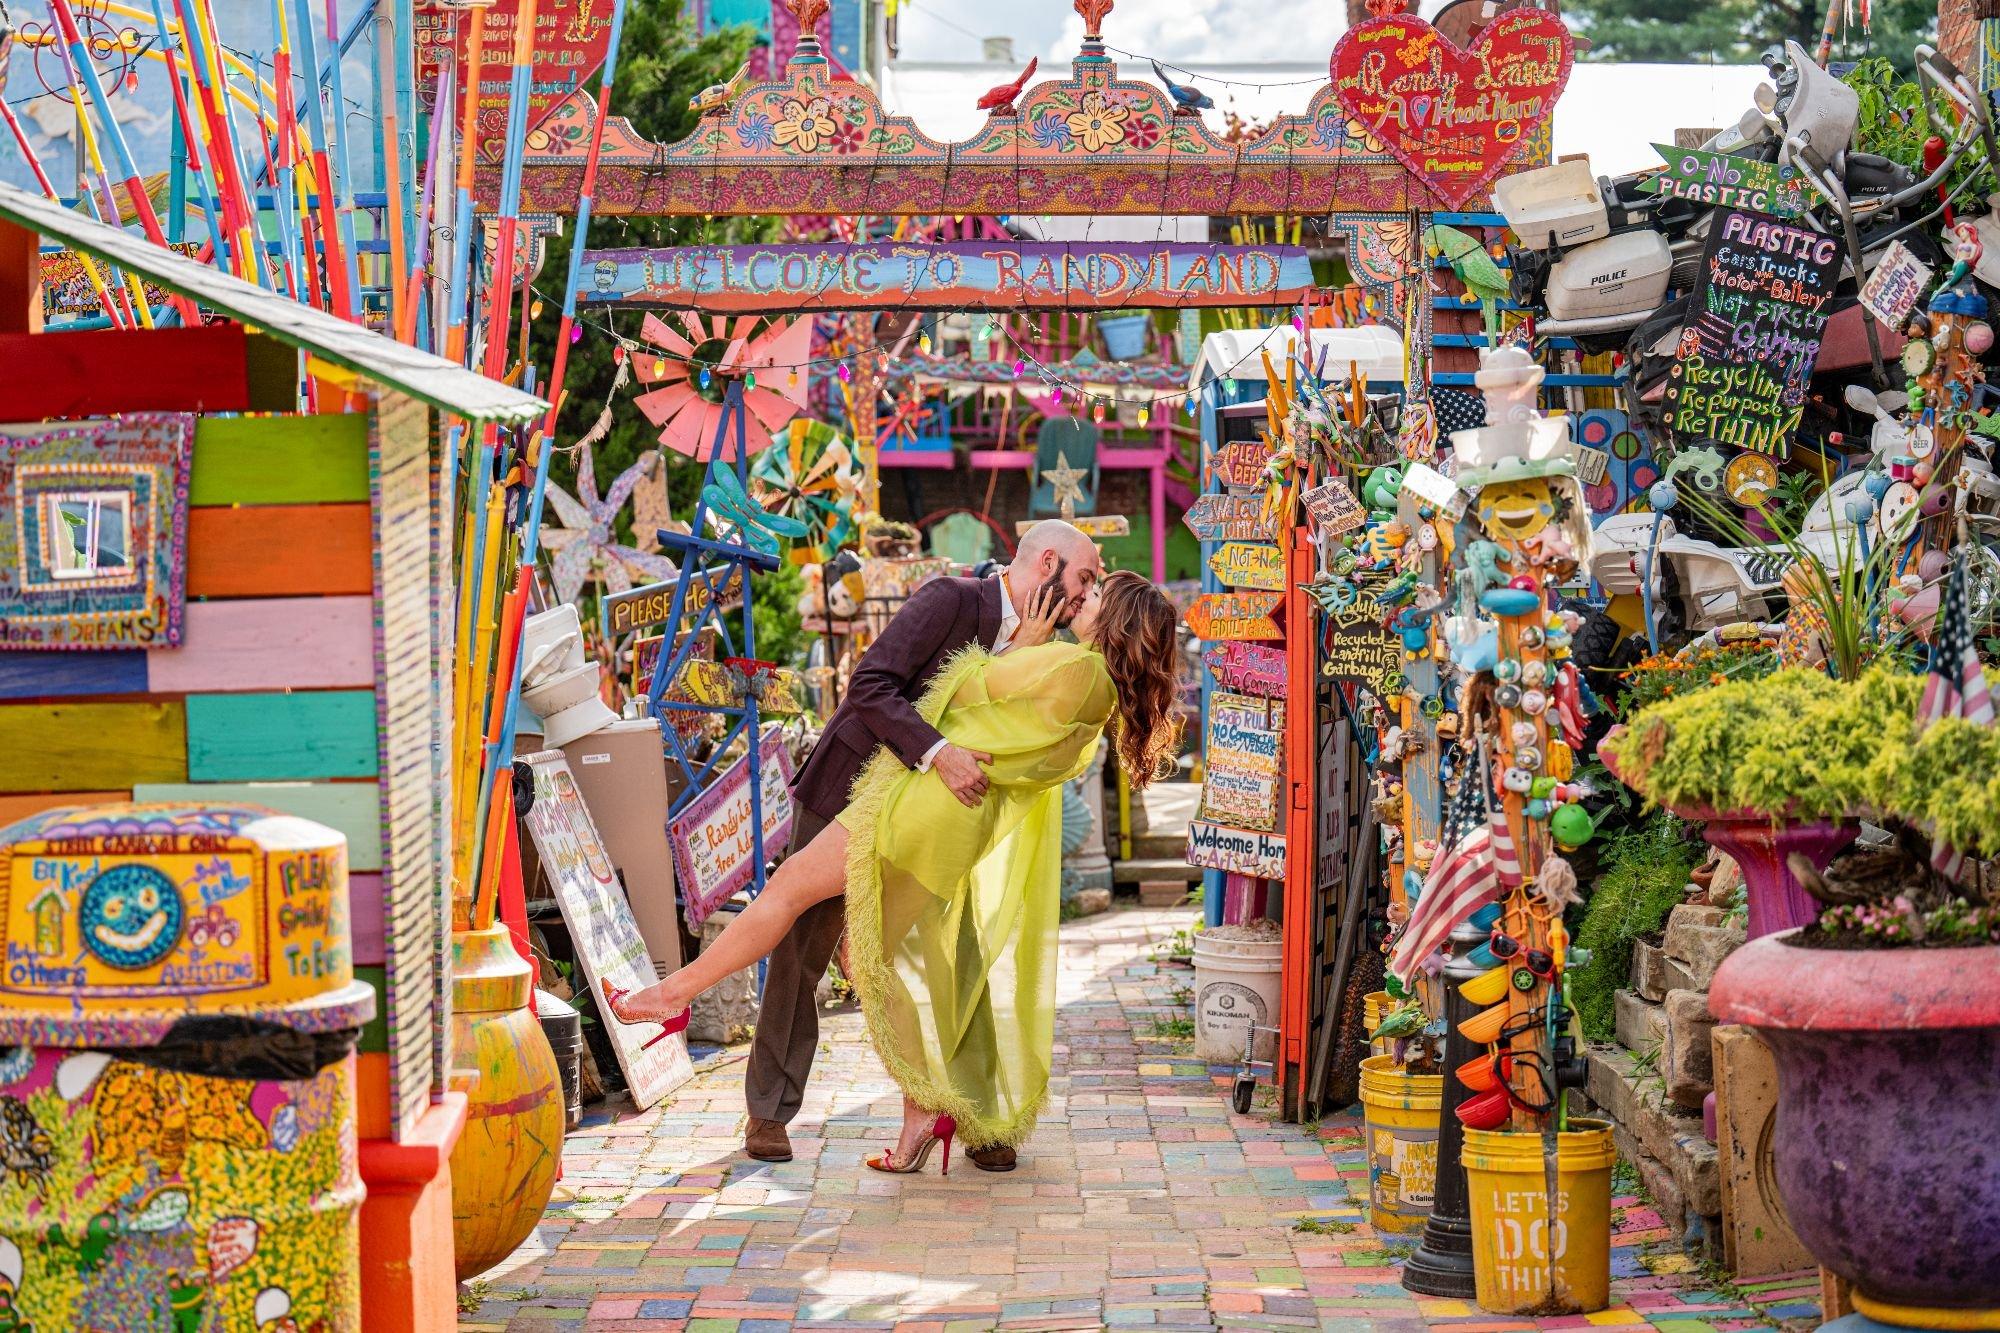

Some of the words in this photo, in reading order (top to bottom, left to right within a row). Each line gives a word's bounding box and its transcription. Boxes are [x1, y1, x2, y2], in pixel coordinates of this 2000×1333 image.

[1359, 46, 1463, 103] Randy
[1473, 38, 1561, 90] Land
[1374, 95, 1409, 130] A
[1658, 176, 1768, 210] PLASTIC
[1722, 213, 1837, 266] PLASTIC
[642, 248, 885, 298] WELCOME
[892, 247, 965, 296] TO
[981, 249, 1281, 300] RANDYLAND
[1591, 268, 1627, 285] POLICE
[1863, 244, 1905, 302] Garbage
[1872, 268, 1901, 310] Broken
[1880, 261, 1918, 317] Landfill
[1684, 355, 1784, 405] Recycling
[1229, 444, 1269, 466] PLEAS
[1913, 439, 1929, 449] BEER
[1233, 464, 1265, 485] BEFO
[614, 590, 671, 630] PLEASE
[1330, 646, 1382, 663] Landfill
[1334, 629, 1386, 650] Recycled
[1323, 660, 1385, 685] Garbage
[1212, 722, 1228, 739] NO
[1244, 709, 1278, 731] RULS
[1191, 823, 1254, 854] Welcome
[1258, 834, 1287, 860] Hom
[1206, 1010, 1250, 1019] KIKKOMAN
[1494, 1218, 1568, 1261] DO
